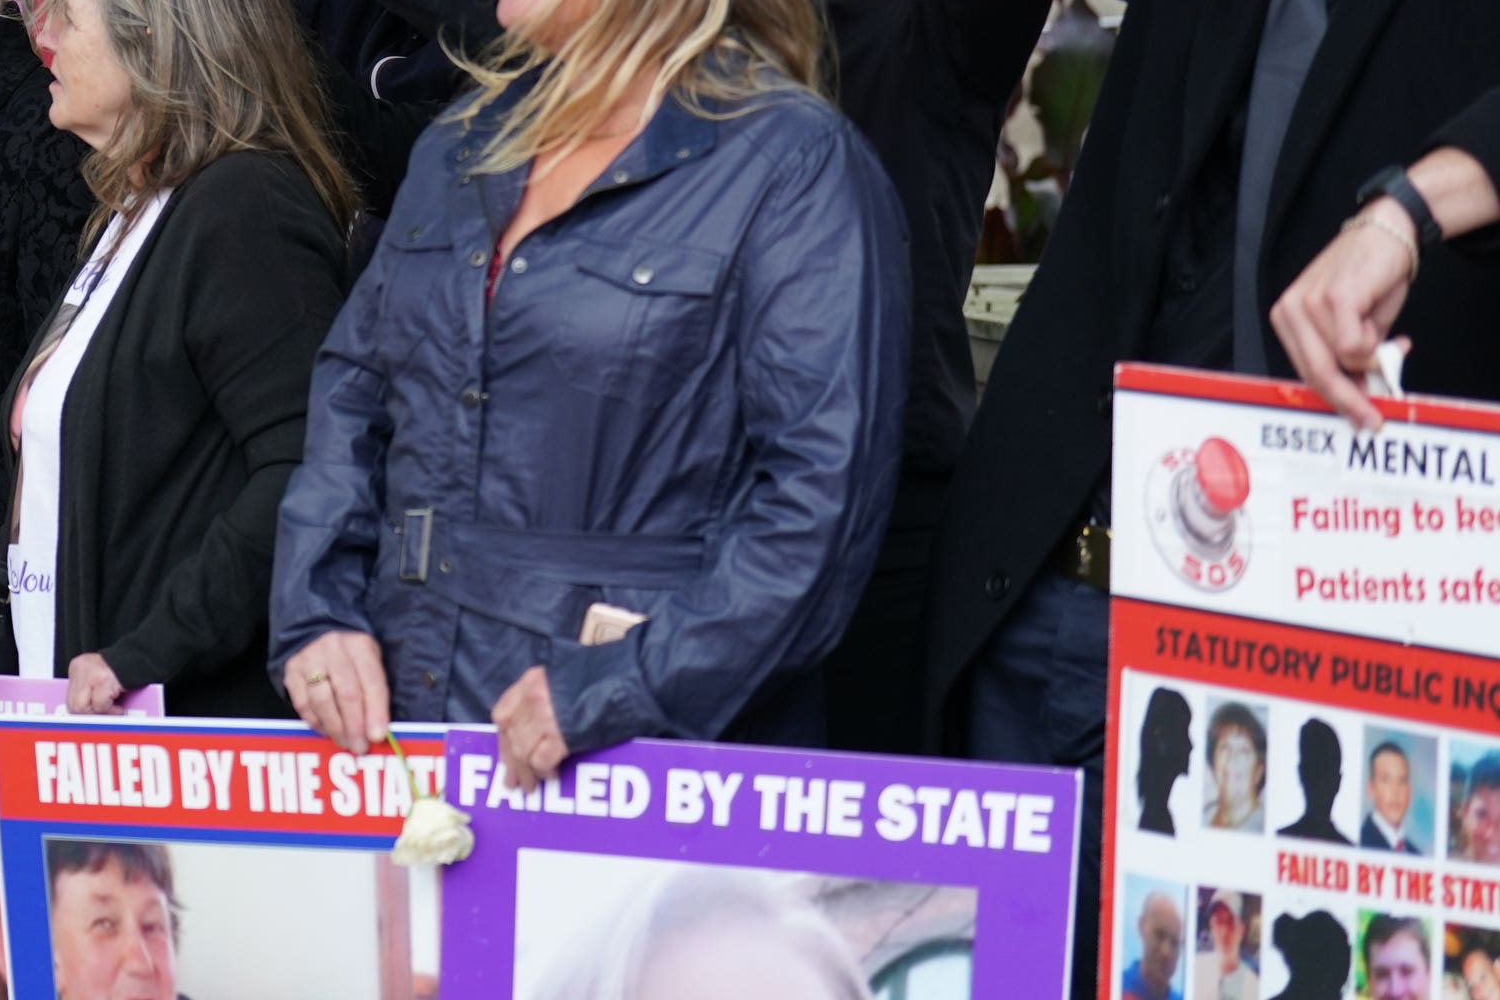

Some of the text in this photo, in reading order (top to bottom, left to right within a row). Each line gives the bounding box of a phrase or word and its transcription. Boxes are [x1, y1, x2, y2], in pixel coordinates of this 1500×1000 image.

[1261, 423, 1495, 486] ESSEX MENTAL
[1291, 497, 1445, 538] Failing to
[1294, 567, 1427, 603] Patients
[1156, 626, 1443, 703] STATUTORY PUBLIC
[34, 741, 171, 808] FAILED
[177, 748, 233, 811] BY
[240, 751, 325, 815] THE
[664, 768, 1055, 854] BY THE STATE
[1277, 851, 1433, 905] FAILED BY THE
